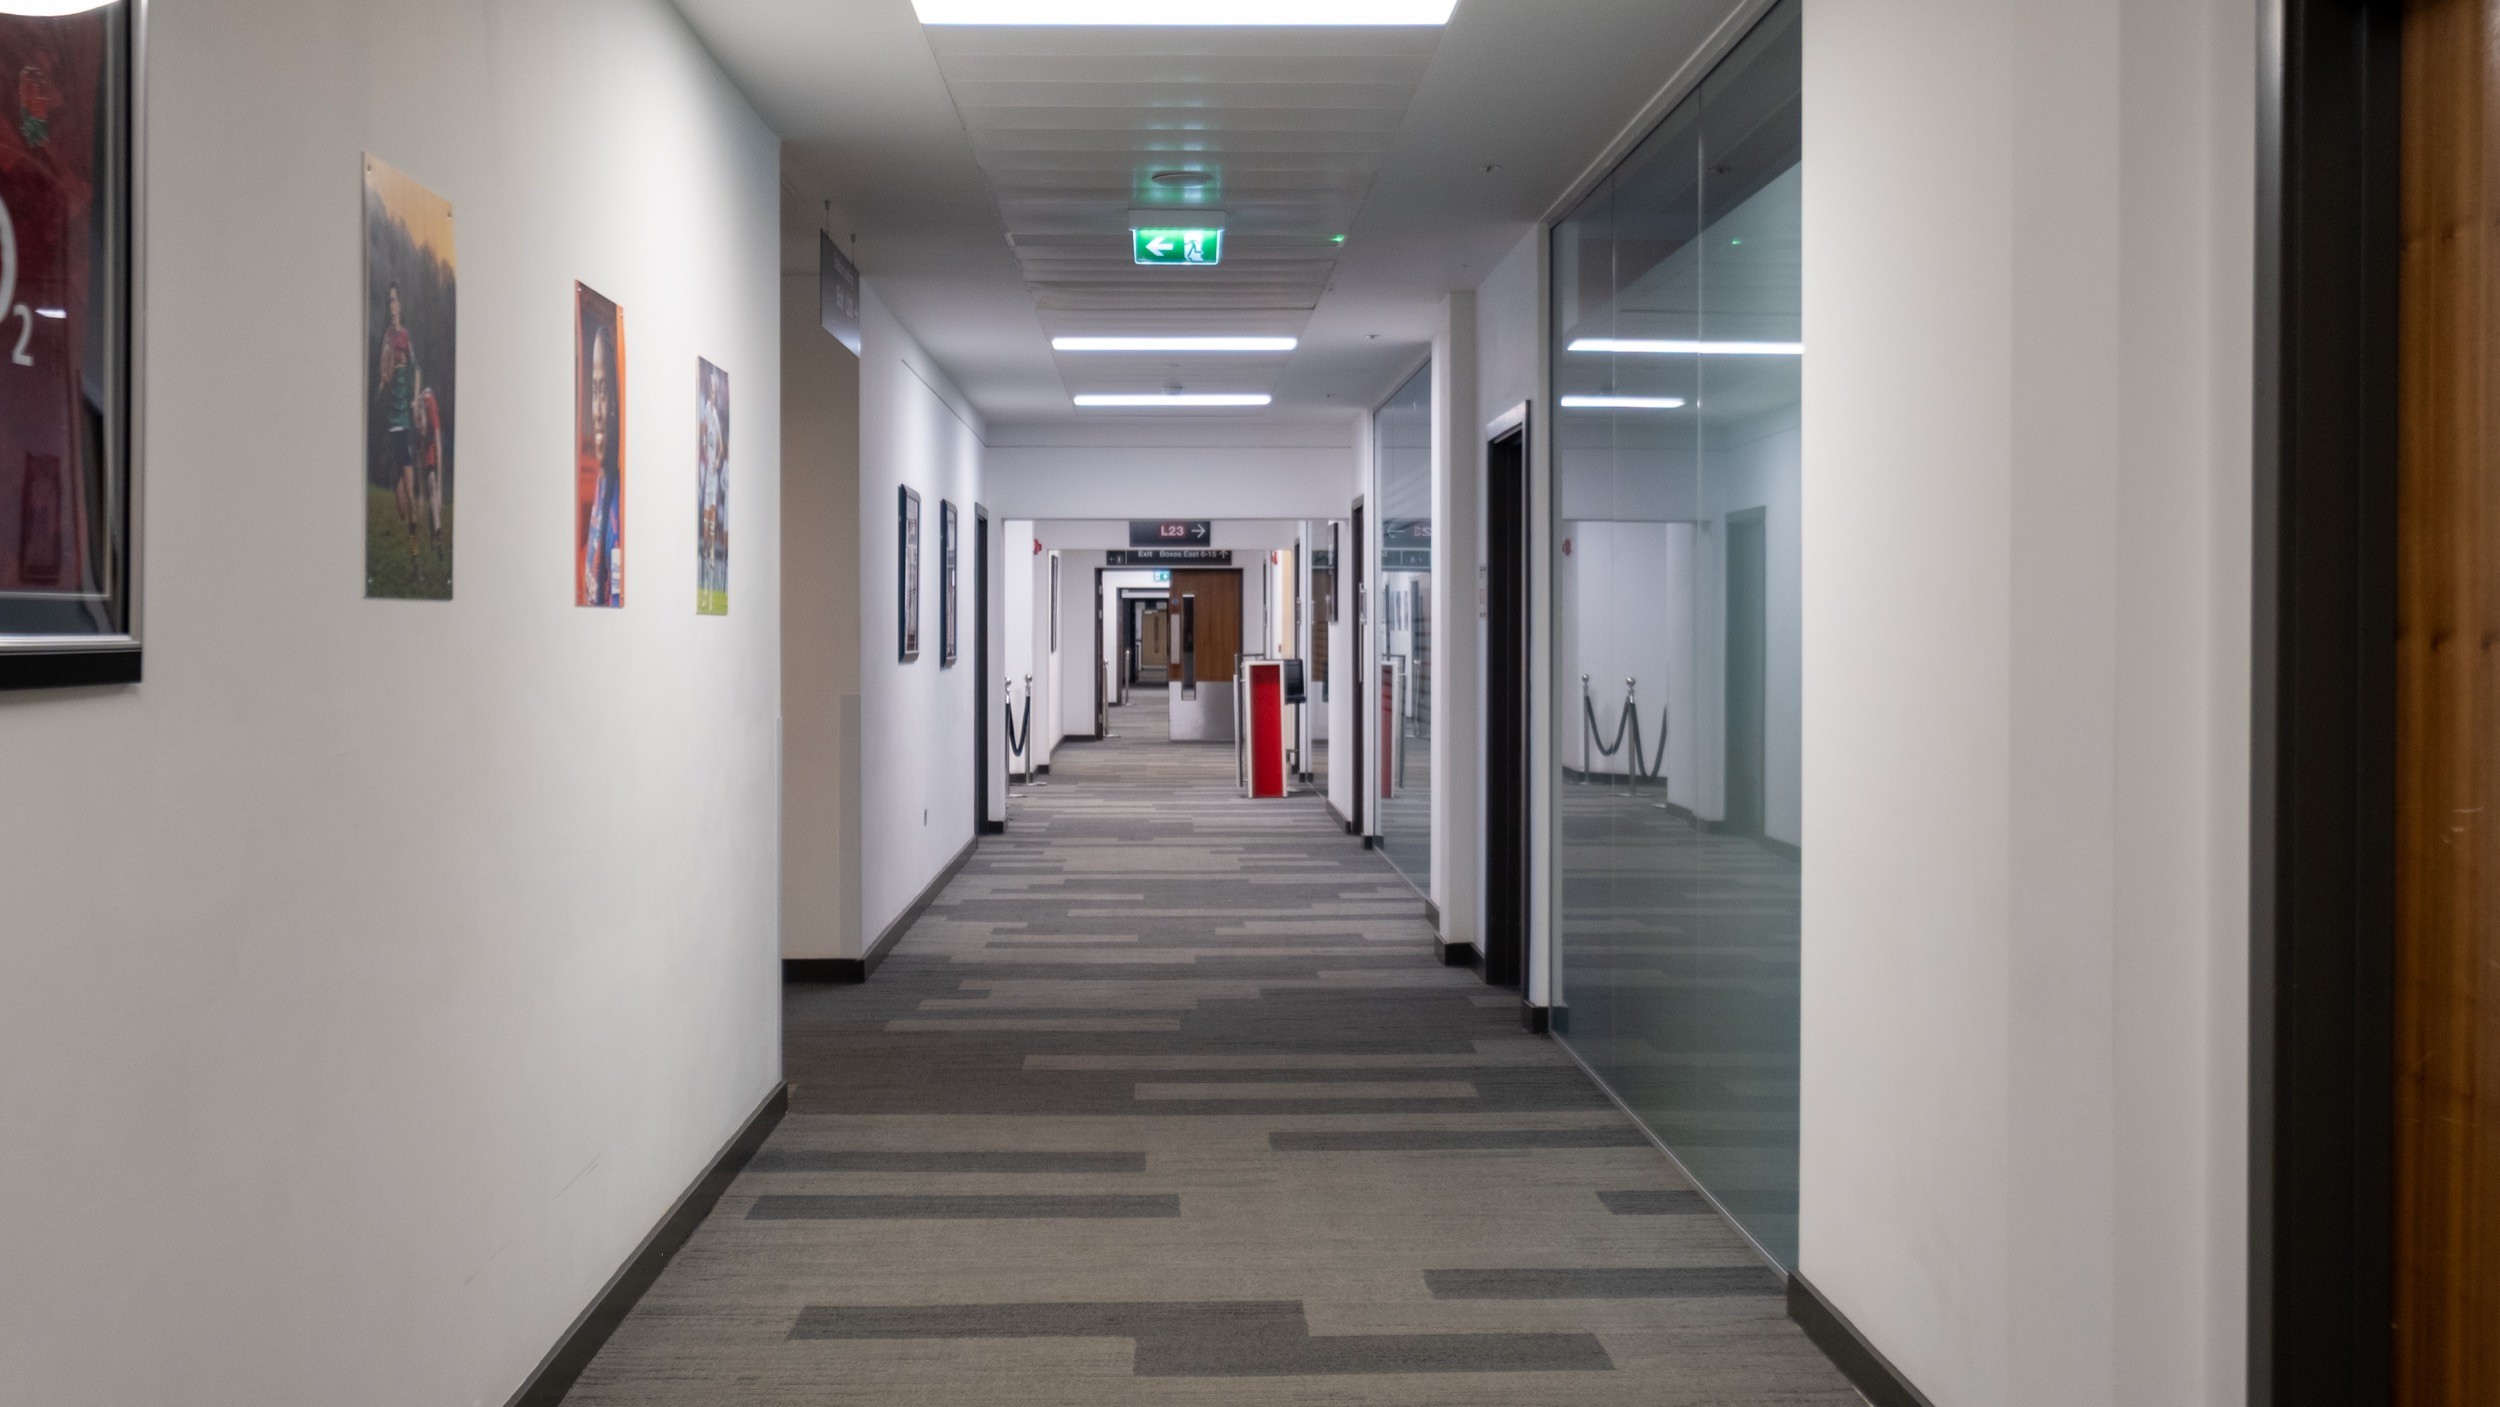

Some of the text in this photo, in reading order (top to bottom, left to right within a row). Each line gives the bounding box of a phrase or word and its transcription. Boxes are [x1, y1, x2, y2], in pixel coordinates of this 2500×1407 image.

[1160, 525, 1185, 537] L23
[1138, 550, 1153, 558] Exit
[1159, 550, 1182, 558] Boxes
[1183, 550, 1199, 558] East
